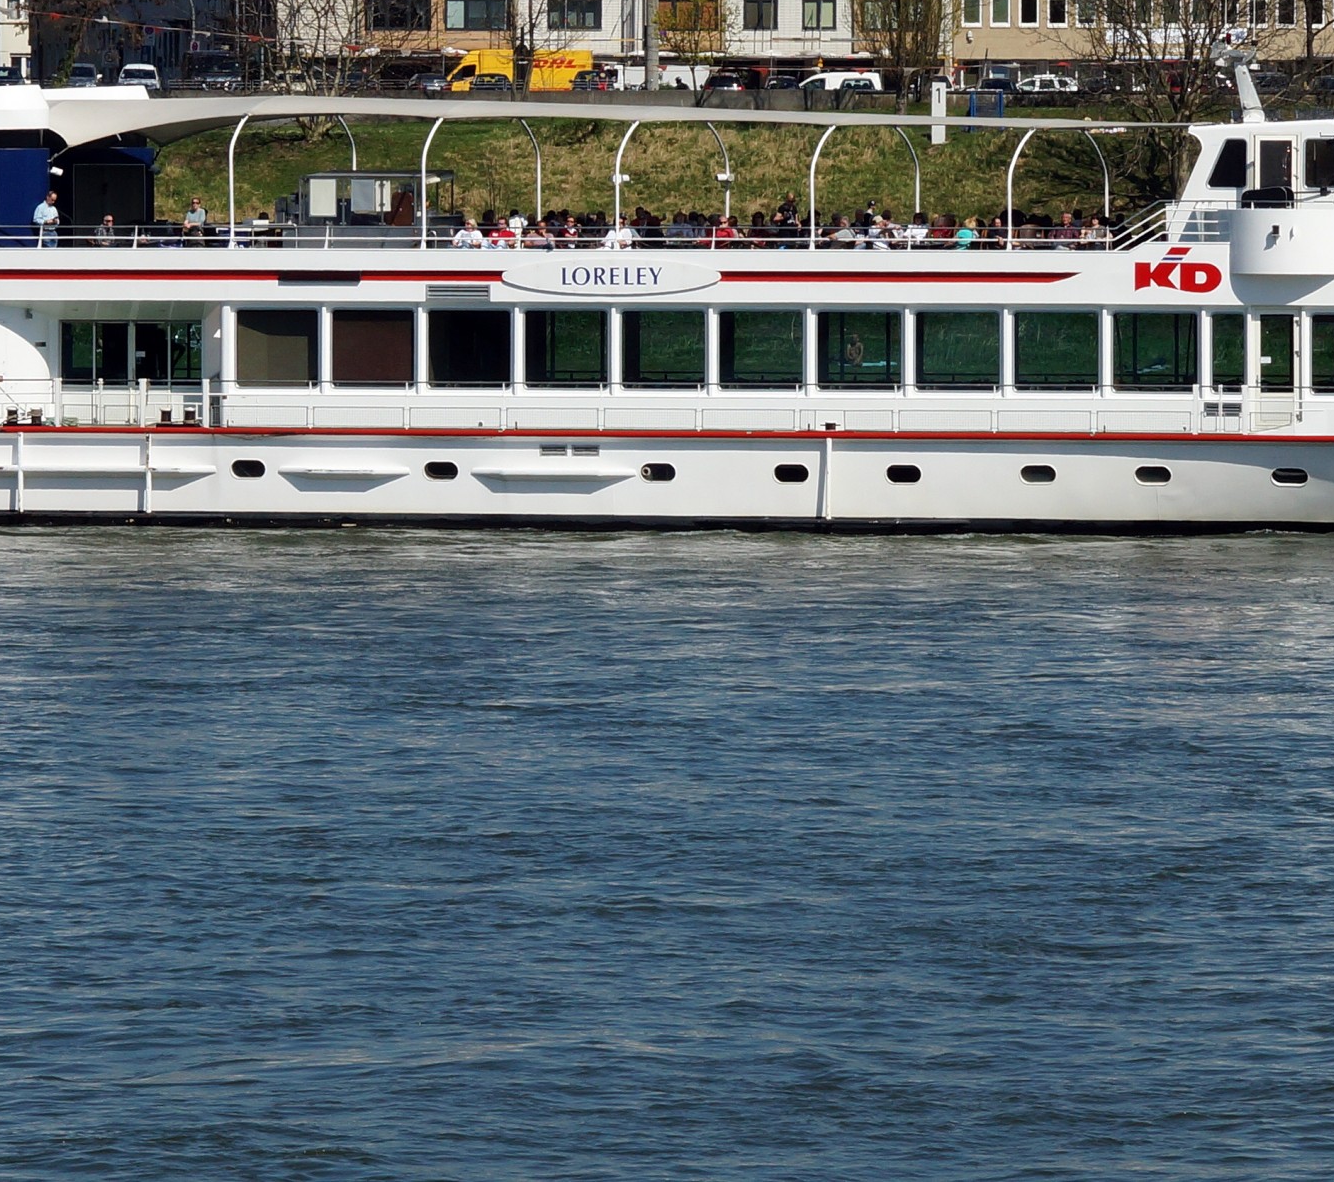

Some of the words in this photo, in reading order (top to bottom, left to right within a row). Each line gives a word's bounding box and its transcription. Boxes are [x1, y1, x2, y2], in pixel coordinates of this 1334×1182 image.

[532, 58, 577, 69] DHL
[935, 87, 941, 104] 1
[561, 266, 663, 286] LORELEY
[1134, 260, 1223, 294] KD
